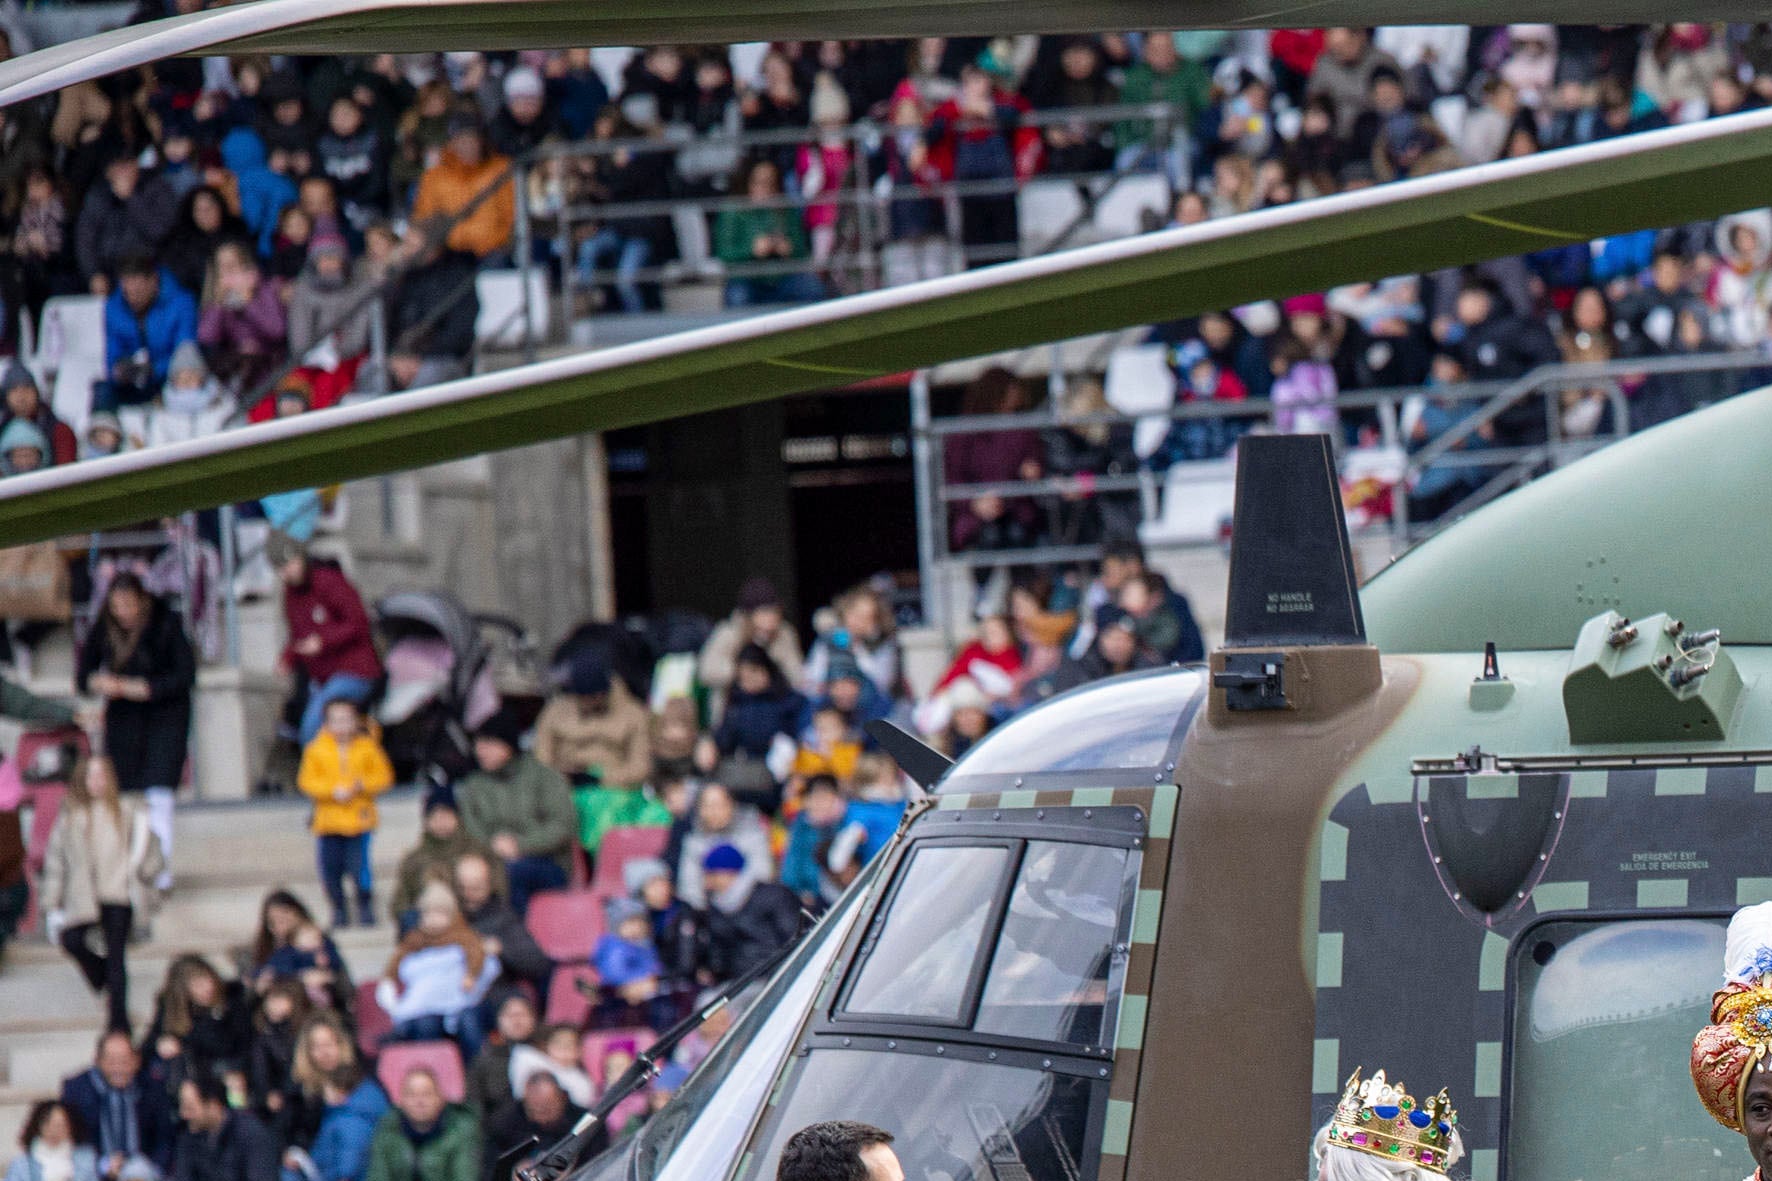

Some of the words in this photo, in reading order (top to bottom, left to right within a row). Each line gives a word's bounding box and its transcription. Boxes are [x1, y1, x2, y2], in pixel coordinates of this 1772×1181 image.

[1632, 852, 1678, 862] EMERGENCY
[1680, 851, 1697, 861] EXIT
[1619, 862, 1647, 872] SALIDA
[1648, 862, 1660, 871] DE
[1661, 860, 1709, 871] EMERGENCIA
